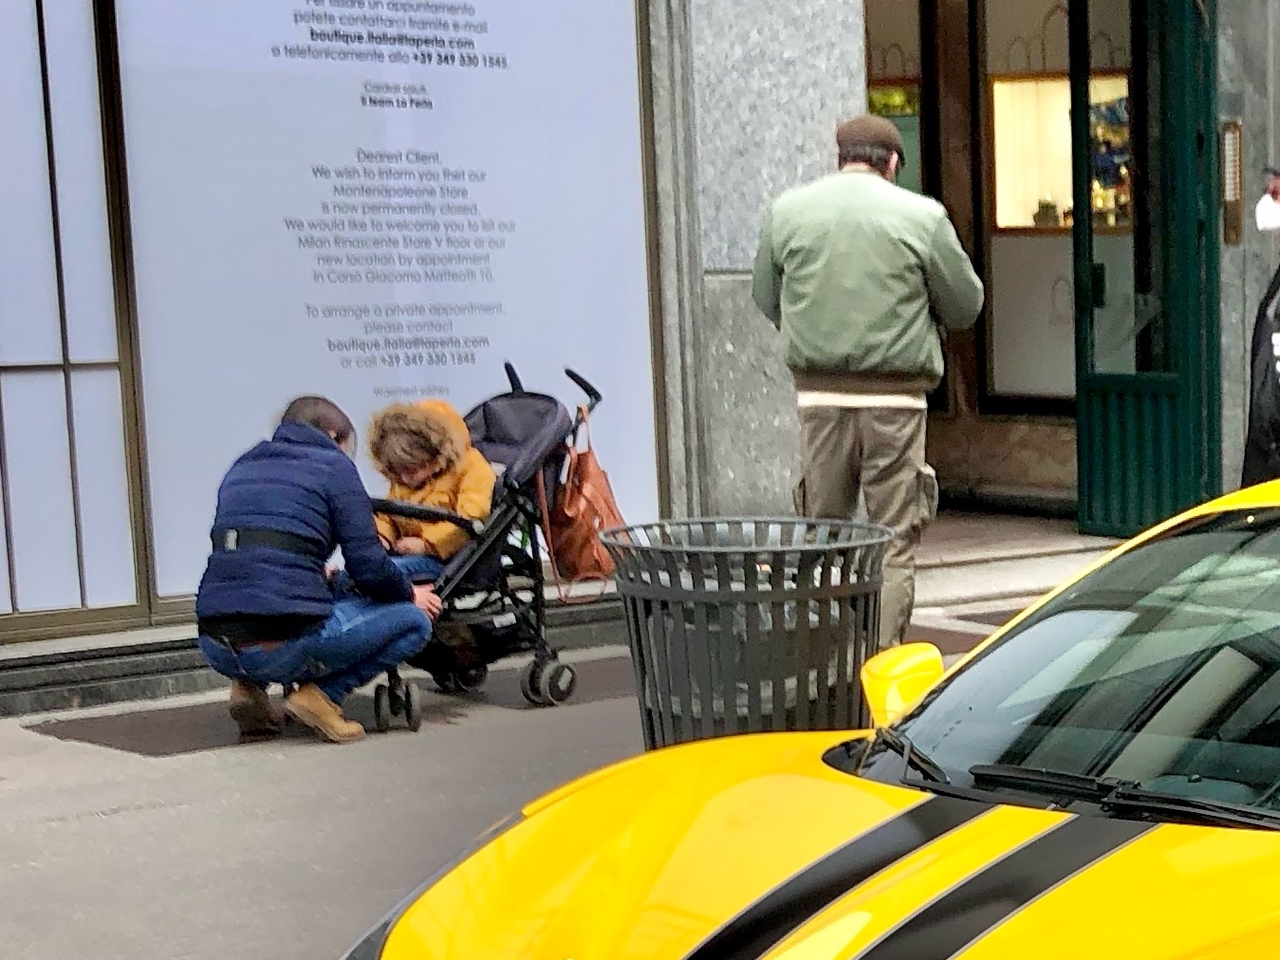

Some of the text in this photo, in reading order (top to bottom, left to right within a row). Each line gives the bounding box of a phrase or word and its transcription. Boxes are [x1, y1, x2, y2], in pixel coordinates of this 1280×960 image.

[357, 147, 403, 163] Dearest
[311, 164, 331, 180] We
[334, 165, 360, 180] wish
[363, 166, 376, 180] to
[418, 169, 440, 183] you
[440, 186, 469, 199] Store
[333, 203, 359, 214] now
[362, 202, 437, 217] permanently
[284, 217, 304, 231] We
[308, 218, 345, 232] would
[371, 219, 383, 232] to
[386, 218, 440, 232] welcome
[443, 219, 465, 235] you
[467, 218, 479, 233] to
[402, 235, 432, 250] Store
[317, 252, 490, 268] new location by appointment
[327, 271, 363, 284] Corso
[365, 269, 422, 284] Giacomo
[306, 303, 320, 318] To
[322, 304, 370, 320] arrange
[386, 303, 426, 318] private
[364, 320, 404, 335] please
